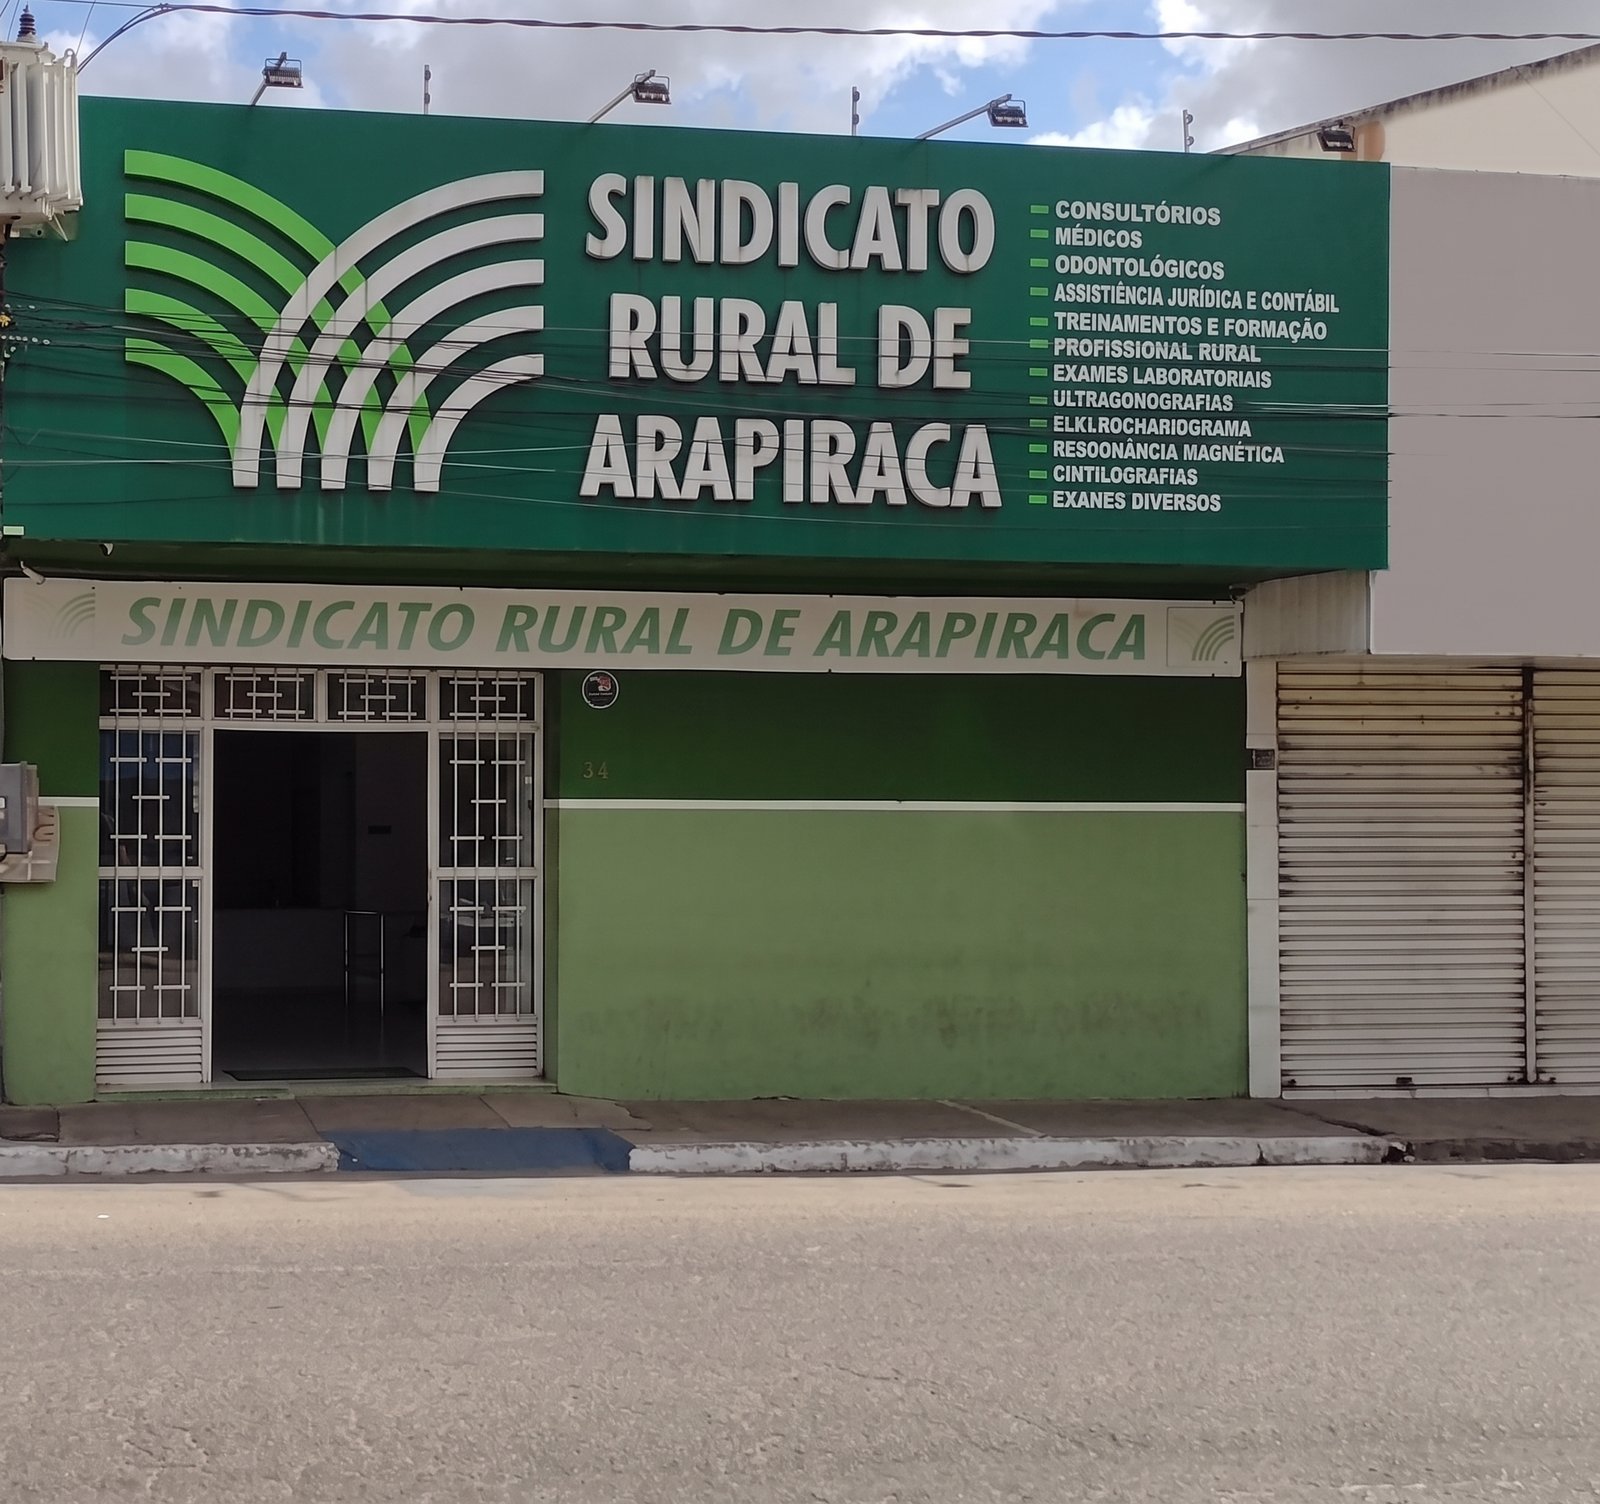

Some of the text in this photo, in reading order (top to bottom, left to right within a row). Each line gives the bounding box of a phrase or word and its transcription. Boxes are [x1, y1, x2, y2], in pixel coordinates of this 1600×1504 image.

[585, 172, 996, 274] SINDICATO
[1055, 201, 1221, 225] CONSULTÓRIOS
[1054, 223, 1143, 249] MÉDICOS
[1054, 254, 1225, 281] ODONTOLÓGICOS
[1054, 281, 1340, 313] ASSISTIÊNCIA JURÍDICA E CONTÁBIL
[1054, 312, 1327, 343] TREINAMENTOS E FORMAÇÃO
[608, 293, 972, 390] RURAL DE
[1053, 338, 1262, 363] PROFISSIONAL RURAL
[1053, 364, 1272, 389] EXAMES LABORATORIAIS
[1053, 390, 1234, 412] ULTRAGONOGRAFIAS
[579, 414, 1002, 508] ARAPIRACA
[1053, 438, 1285, 463] RESOONÂNCIA MAGNÉTICA
[1053, 465, 1198, 486] CINTILOGRAFIAS
[1053, 491, 1222, 512] EXANES DIVERSOS
[122, 598, 1146, 660] SINDICATO RURAL DE ARAPIRACA
[583, 761, 609, 779] 34
